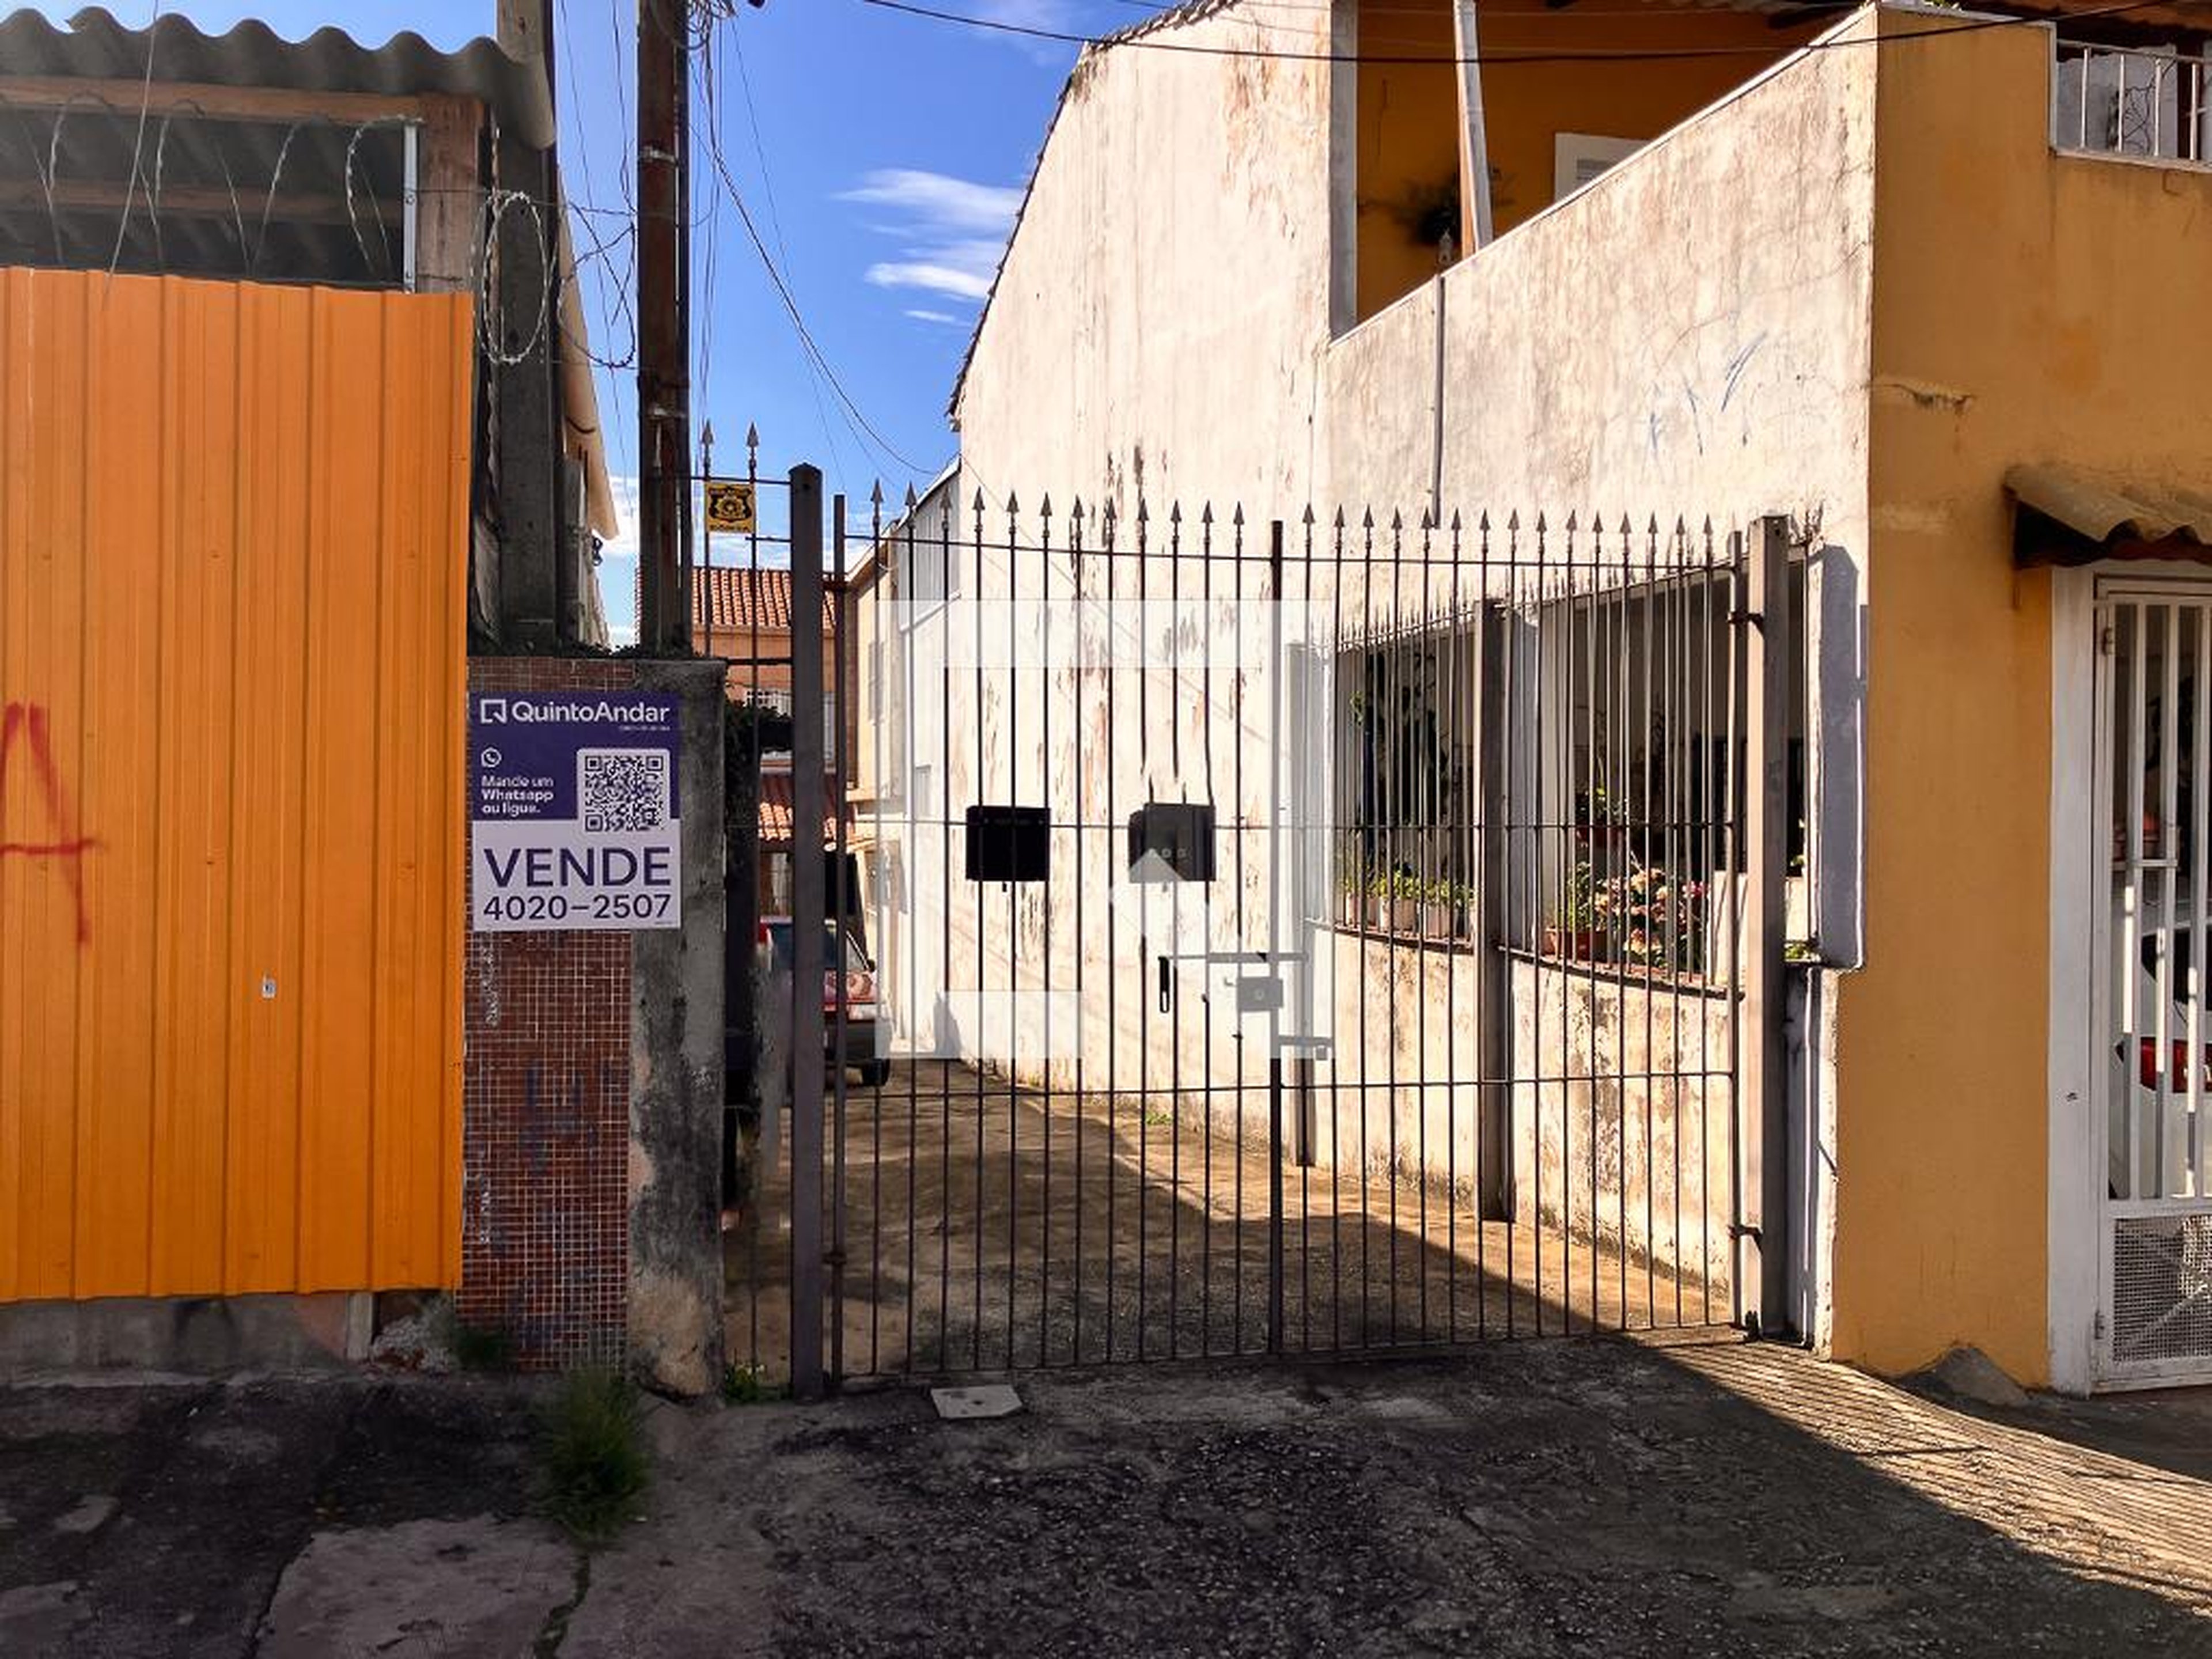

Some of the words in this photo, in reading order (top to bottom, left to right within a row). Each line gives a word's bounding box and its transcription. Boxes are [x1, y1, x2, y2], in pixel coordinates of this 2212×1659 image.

[512, 702, 671, 722] QuintoAndar
[481, 775, 529, 787] Mande
[531, 777, 554, 787] um
[482, 804, 500, 814] ou
[483, 847, 671, 887] VENDE
[483, 893, 671, 921] 4020-2507
